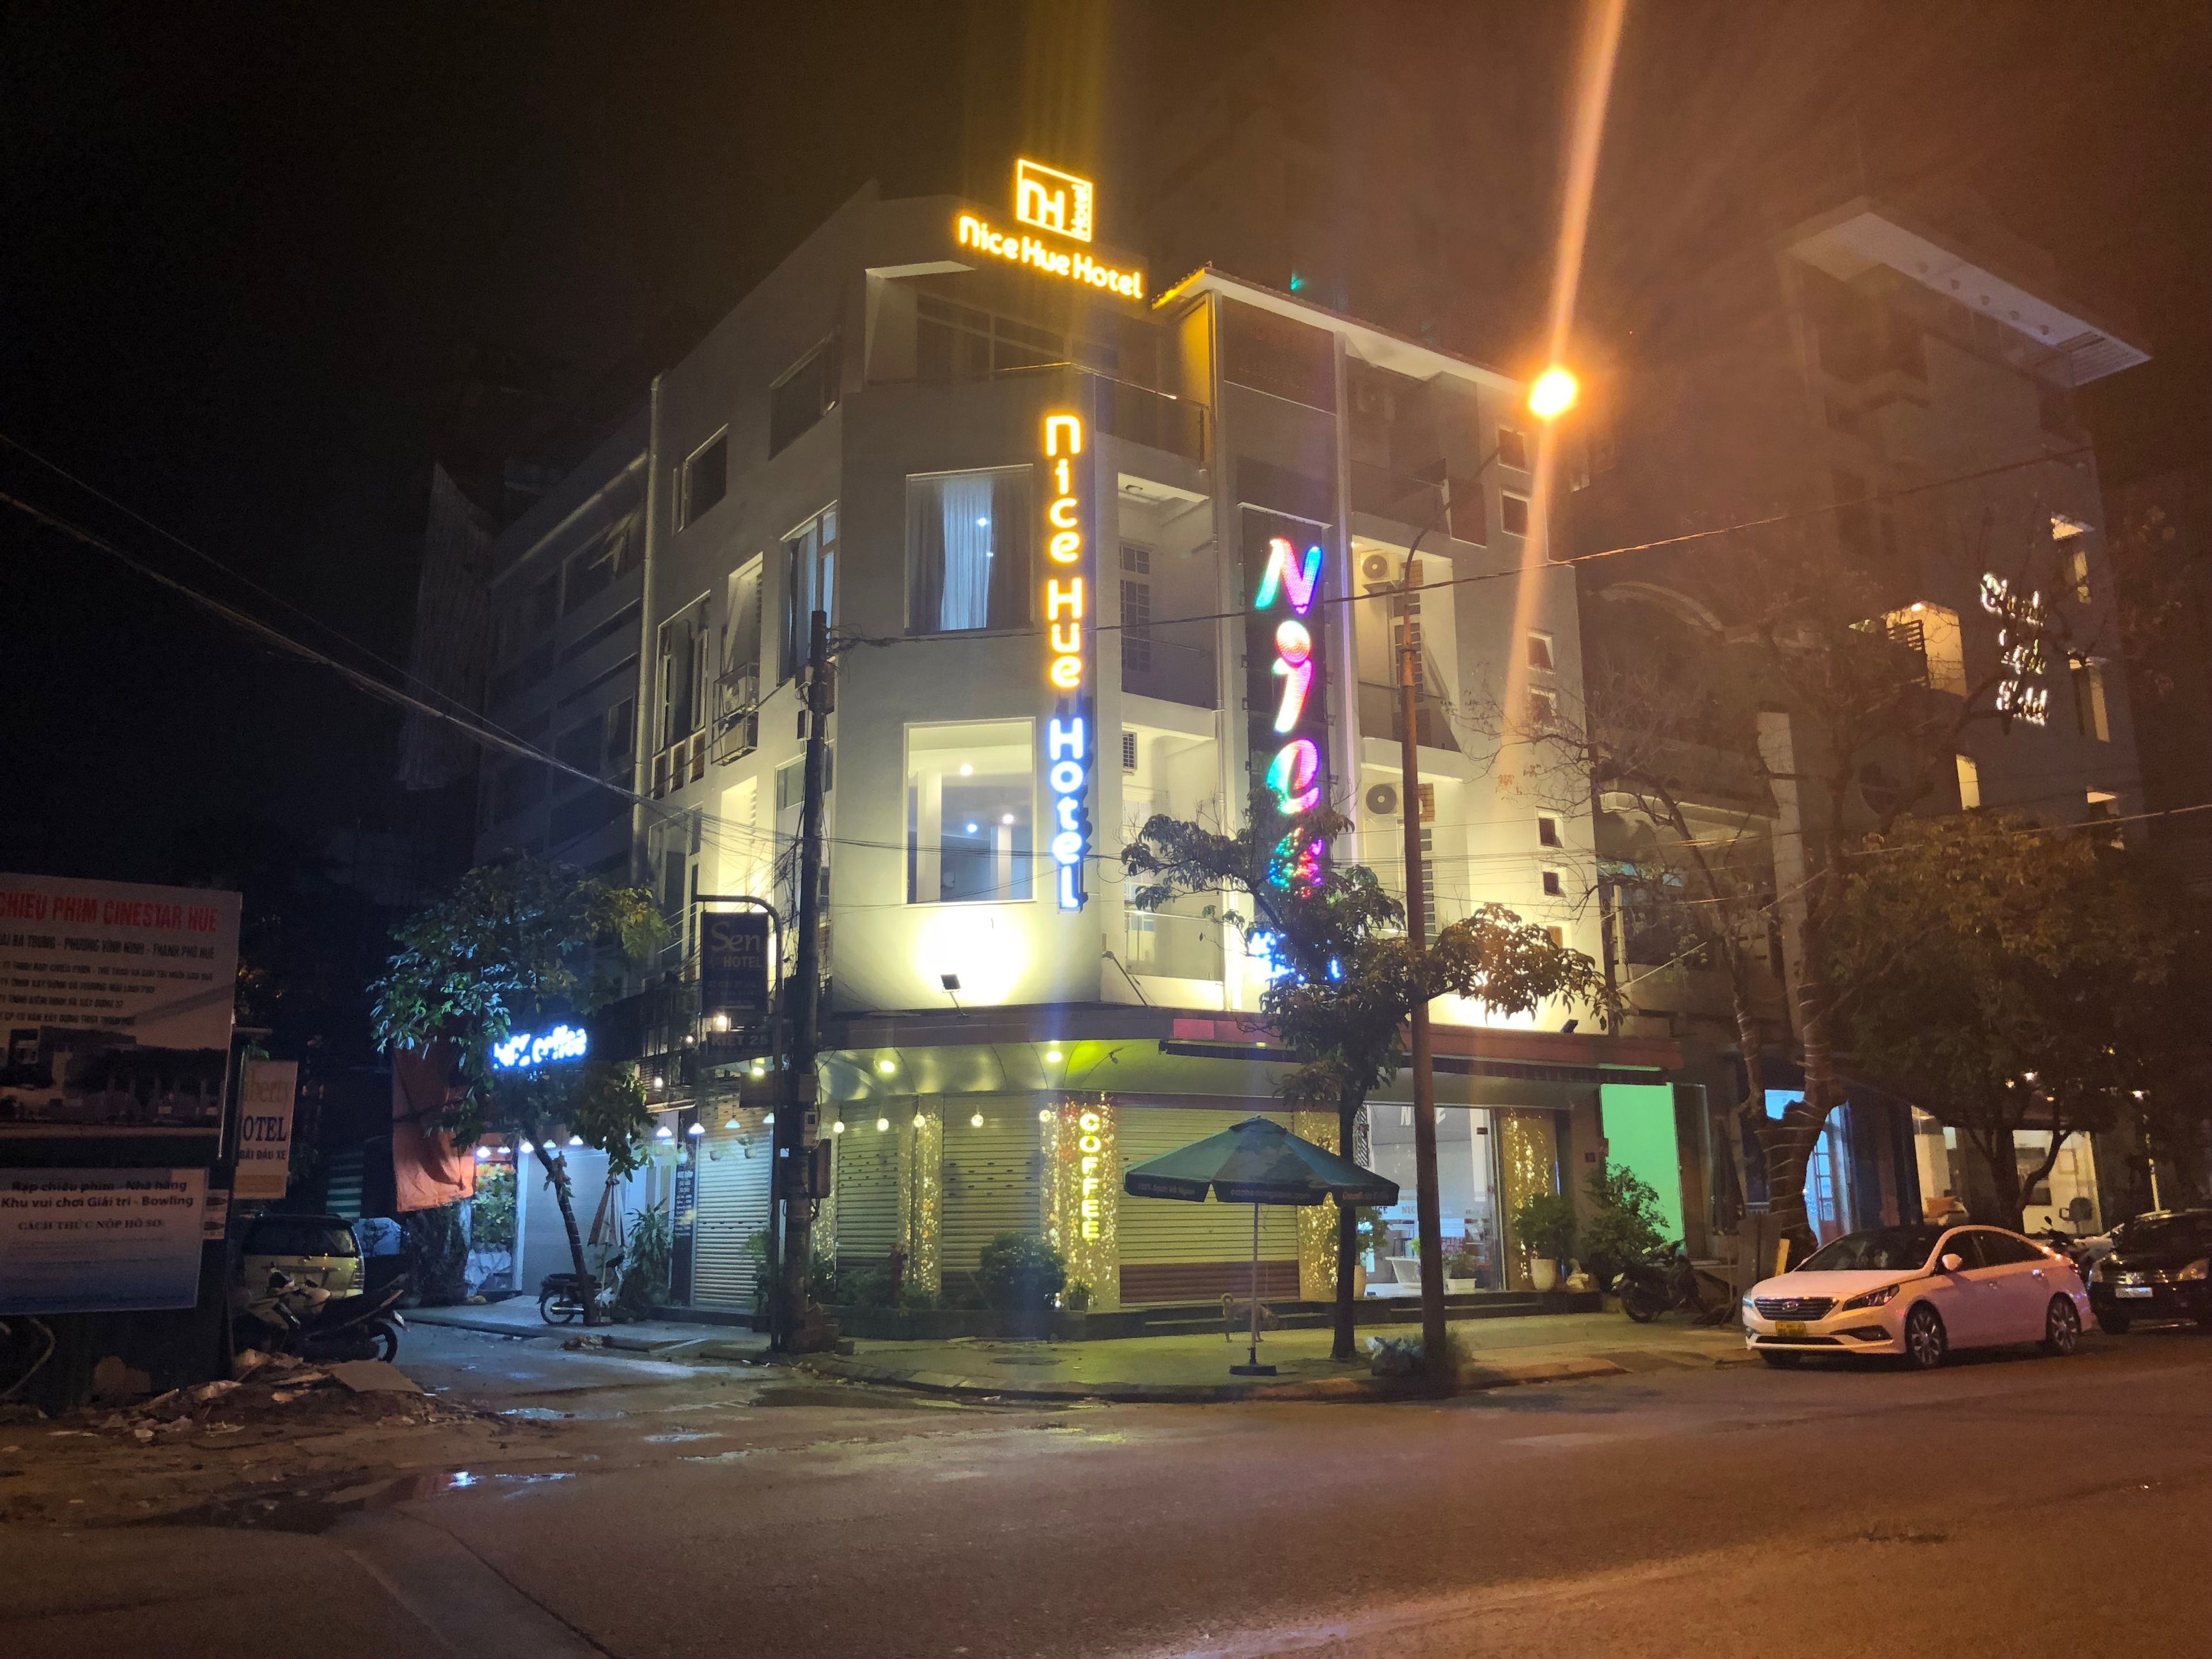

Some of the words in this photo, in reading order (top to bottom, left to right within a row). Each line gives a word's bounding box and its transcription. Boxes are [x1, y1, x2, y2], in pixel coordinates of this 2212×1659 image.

[959, 215, 1019, 260] Nice
[1021, 236, 1071, 276] Hue
[1072, 252, 1143, 300] Hotel
[1047, 577, 1084, 689] Hue
[1048, 718, 1085, 909] Hotel
[710, 921, 761, 953] Sen
[723, 956, 764, 968] HOTEL
[243, 1115, 287, 1142] OTEL
[1, 1196, 28, 1208] Khu
[32, 1197, 52, 1208] vui
[142, 1196, 194, 1208] Bowling
[1079, 1112, 1101, 1239] COFFEE
